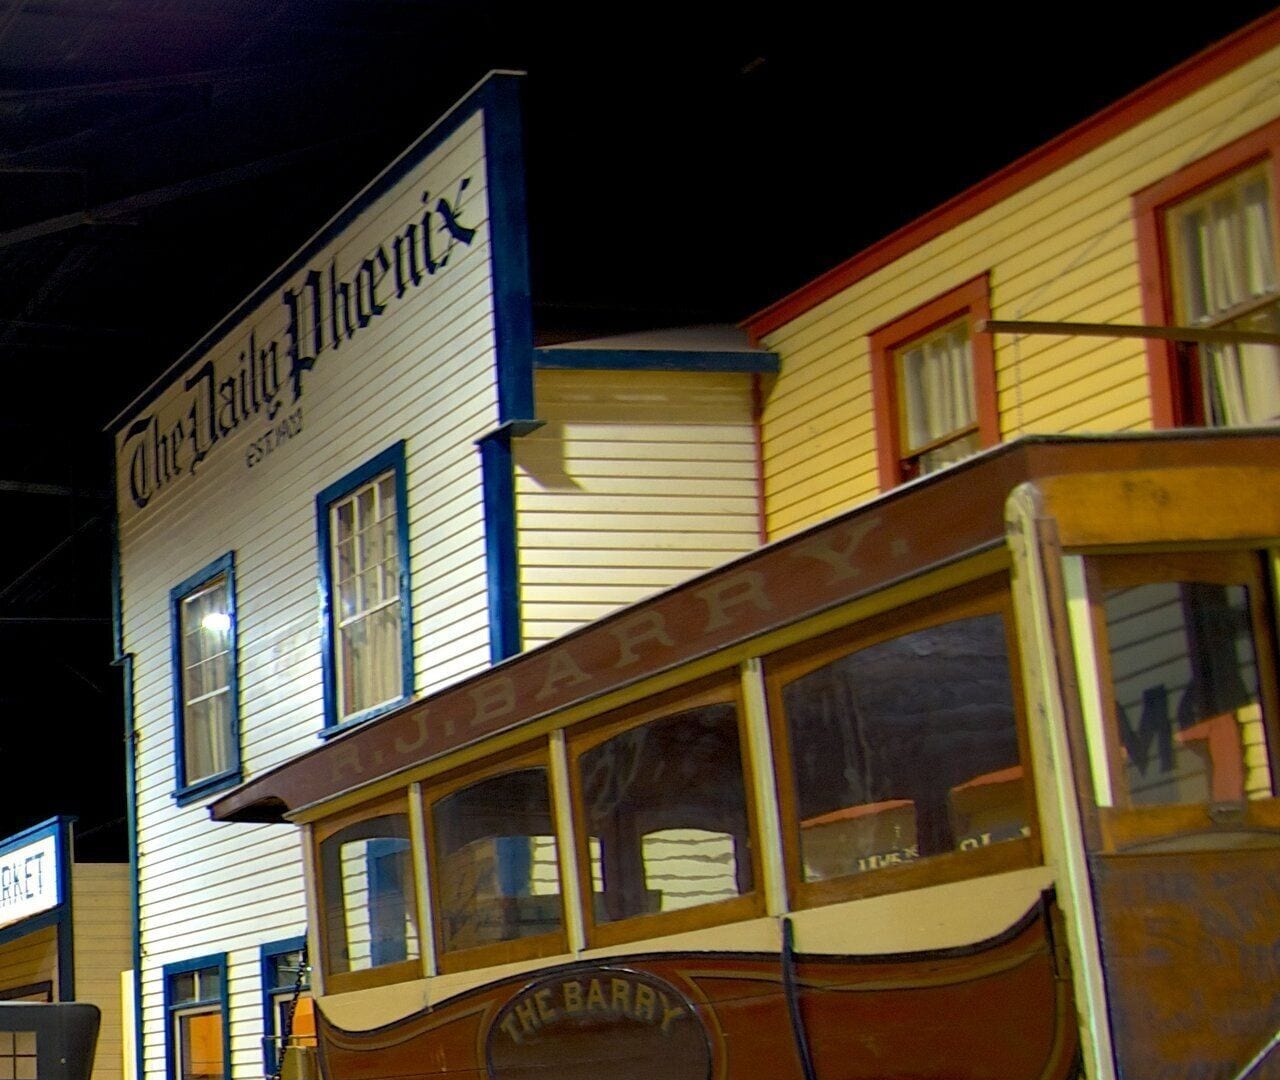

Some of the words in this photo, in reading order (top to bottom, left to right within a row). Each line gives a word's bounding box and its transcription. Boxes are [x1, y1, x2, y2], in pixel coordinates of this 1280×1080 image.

[122, 415, 184, 508] The
[184, 326, 282, 476] Daily
[500, 988, 557, 1044] THE
[562, 978, 684, 1034] BARRY
